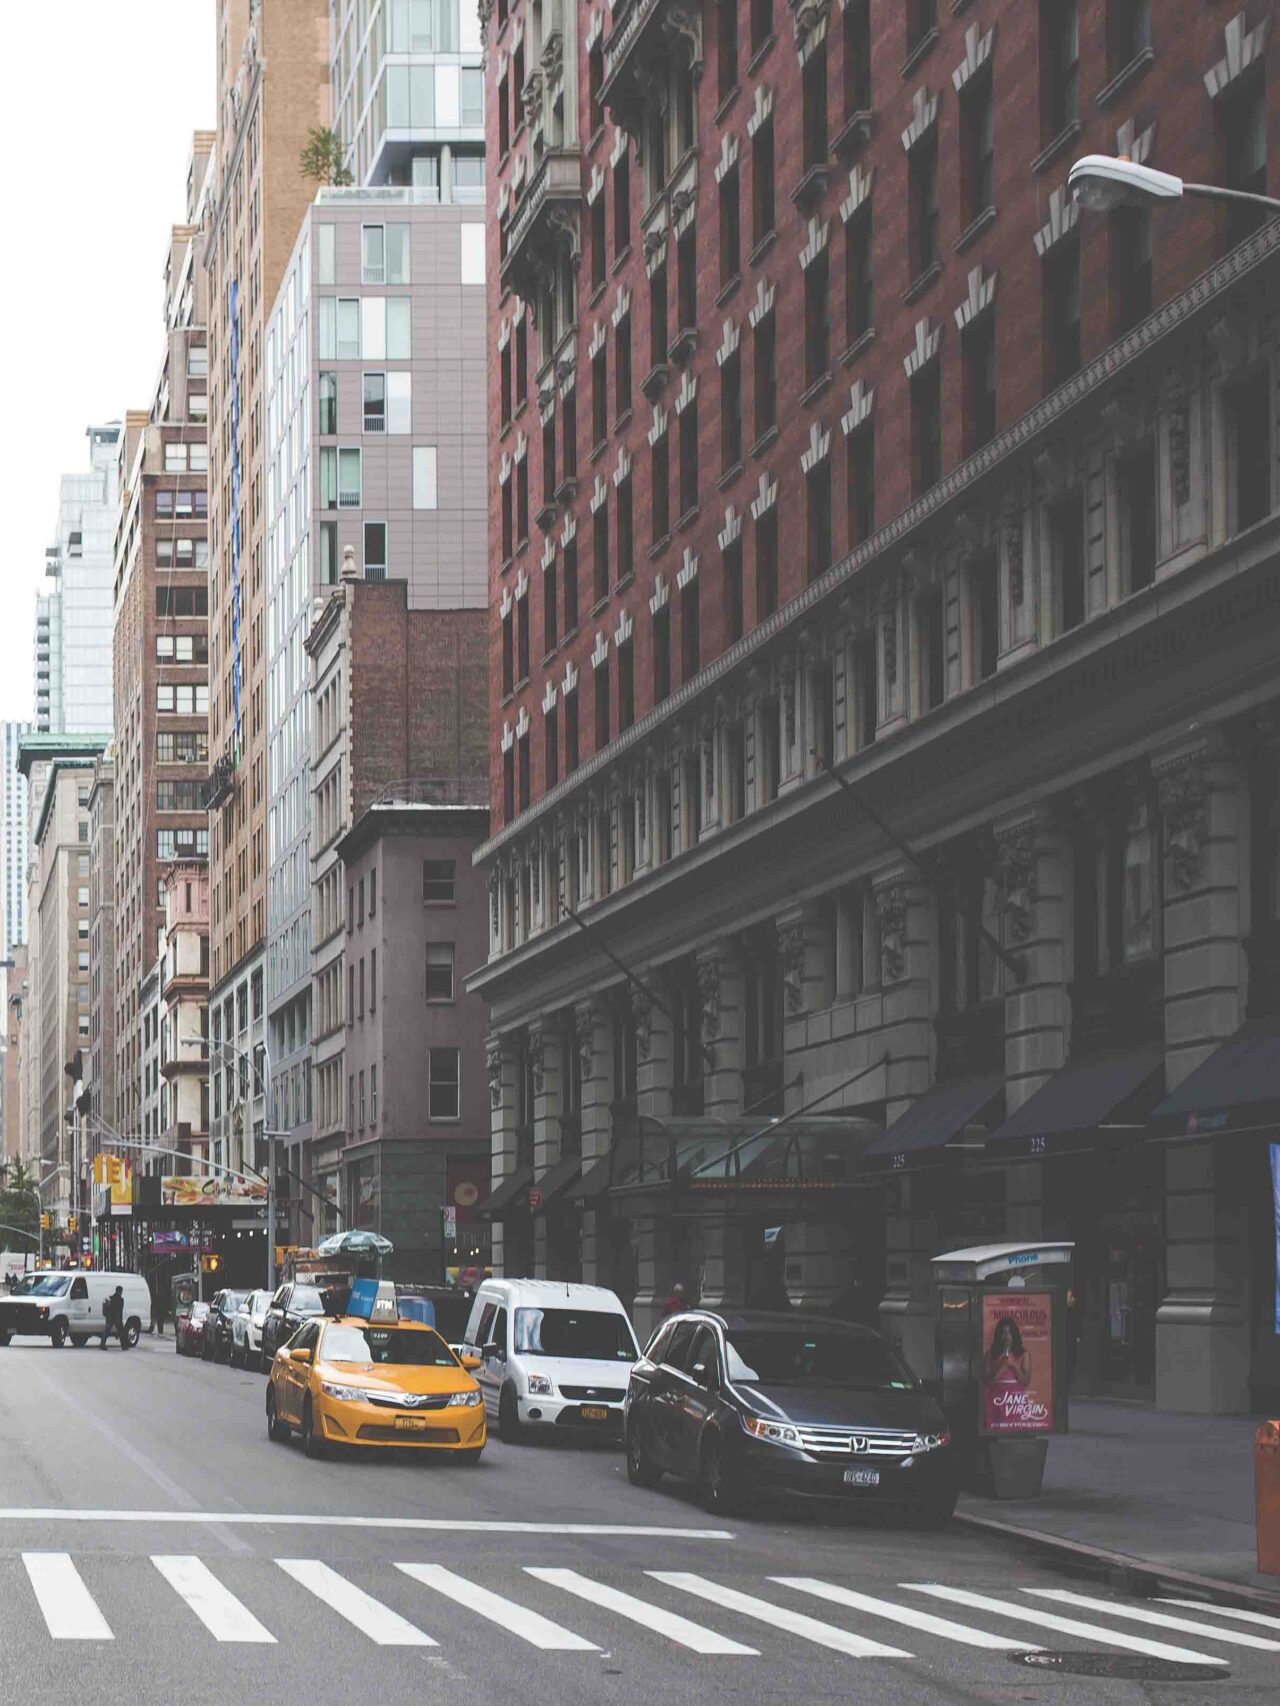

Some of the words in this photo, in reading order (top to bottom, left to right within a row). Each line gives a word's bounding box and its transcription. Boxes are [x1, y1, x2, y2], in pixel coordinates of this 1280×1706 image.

[1031, 1138, 1046, 1152] 225
[1008, 1253, 1039, 1264] Phone
[994, 1391, 1029, 1406] JANE
[1006, 1404, 1048, 1420] VIRGIN
